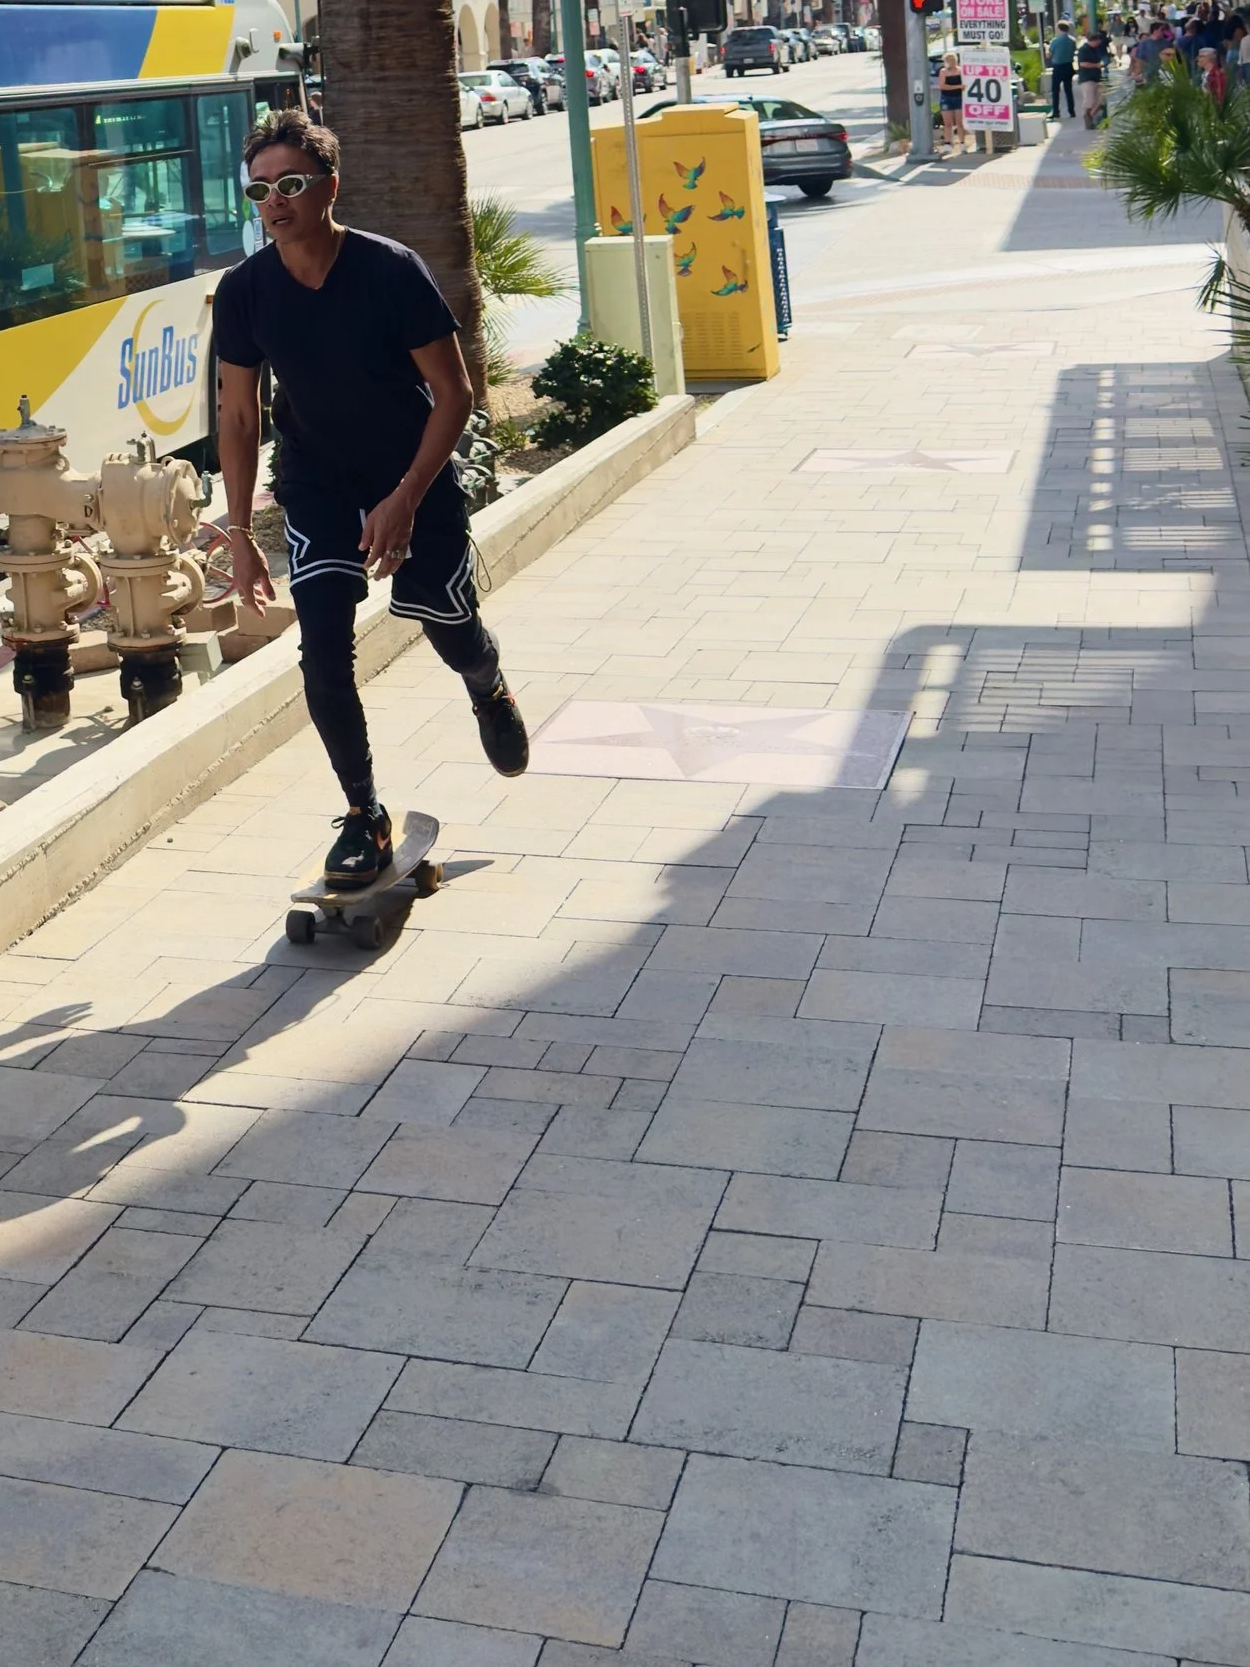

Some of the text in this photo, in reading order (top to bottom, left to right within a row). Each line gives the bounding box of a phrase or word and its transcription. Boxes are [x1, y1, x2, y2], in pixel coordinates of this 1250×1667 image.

[960, 6, 1004, 17] ON SALE!
[960, 20, 1005, 29] EVERYTHING
[963, 30, 1003, 39] MUST GO!
[965, 66, 1004, 75] UP TO
[967, 78, 1001, 103] 40
[969, 105, 1005, 115] OFF
[118, 326, 198, 409] SunBus
